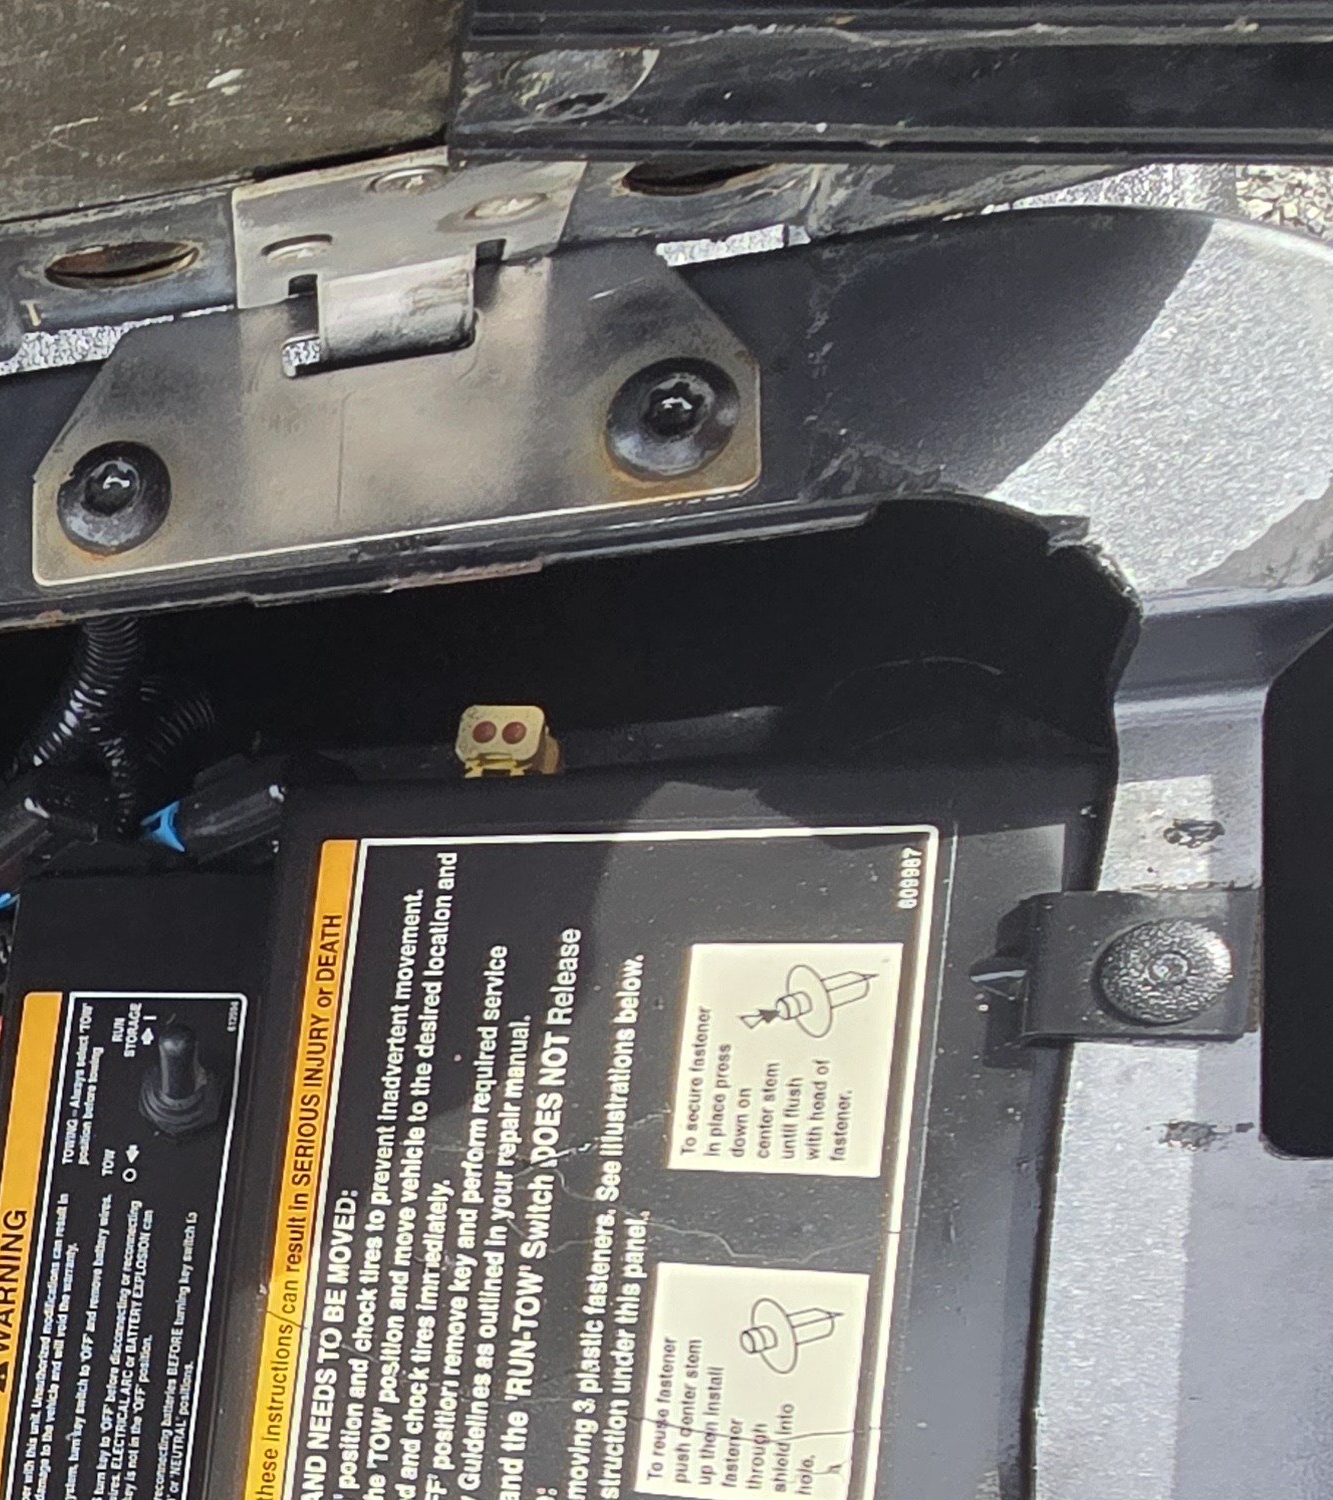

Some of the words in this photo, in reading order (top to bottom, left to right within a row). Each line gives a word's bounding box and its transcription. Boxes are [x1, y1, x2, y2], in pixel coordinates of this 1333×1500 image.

[437, 852, 458, 890] and
[315, 915, 342, 981] DEATH
[395, 889, 424, 1000] movement.
[422, 895, 453, 976] location
[317, 987, 334, 1008] or
[546, 928, 581, 1025] Release
[613, 955, 644, 1024] below.
[111, 1017, 126, 1042] RUN
[123, 1003, 142, 1057] STORAGE
[413, 981, 443, 1058] desired
[76, 1035, 89, 1067] select
[87, 1047, 104, 1083] towing
[303, 1013, 330, 1087] INJURY
[377, 1004, 410, 1121] inadvertent
[539, 1031, 571, 1086] NOT
[69, 1069, 86, 1108] Always
[82, 1084, 97, 1119] before
[409, 1062, 433, 1096] the
[599, 1028, 636, 1156] illustrations
[407, 1101, 428, 1122] to
[530, 1092, 564, 1172] DOES
[62, 1119, 79, 1165] TOWING
[78, 1121, 92, 1165] position
[101, 1149, 116, 1176] TOW
[291, 1094, 320, 1187] SERIOUS
[370, 1125, 396, 1206] prevent
[399, 1127, 426, 1203] vehicle
[288, 1193, 309, 1210] in
[594, 1160, 622, 1202] See
[143, 1209, 154, 1231] can
[326, 1190, 359, 1284] MOVED:
[364, 1209, 386, 1232] to
[393, 1206, 417, 1266] move
[521, 1174, 555, 1259] Switch
[132, 1232, 151, 1299] EXPLOSION
[286, 1217, 306, 1272] result
[358, 1236, 383, 1284] tires
[582, 1209, 617, 1315] fasteners.
[620, 1211, 654, 1278] panel.
[282, 1280, 298, 1314] can
[322, 1289, 347, 1323] BE
[388, 1270, 409, 1311] and
[614, 1283, 641, 1324] this
[125, 1300, 142, 1353] BATTERY
[316, 1327, 343, 1364] TO
[348, 1287, 378, 1352] chock
[120, 1370, 134, 1396] ARC
[125, 1355, 135, 1368] or
[261, 1324, 298, 1442] instructions
[347, 1354, 374, 1399] and
[378, 1315, 405, 1404] position
[575, 1320, 604, 1393] plastic
[610, 1328, 636, 1394] under
[110, 1396, 131, 1470] ELECTRICAL
[306, 1368, 337, 1450] NEEDS
[500, 1411, 529, 1452] the
[338, 1402, 364, 1489] position
[169, 1480, 179, 1493] or
